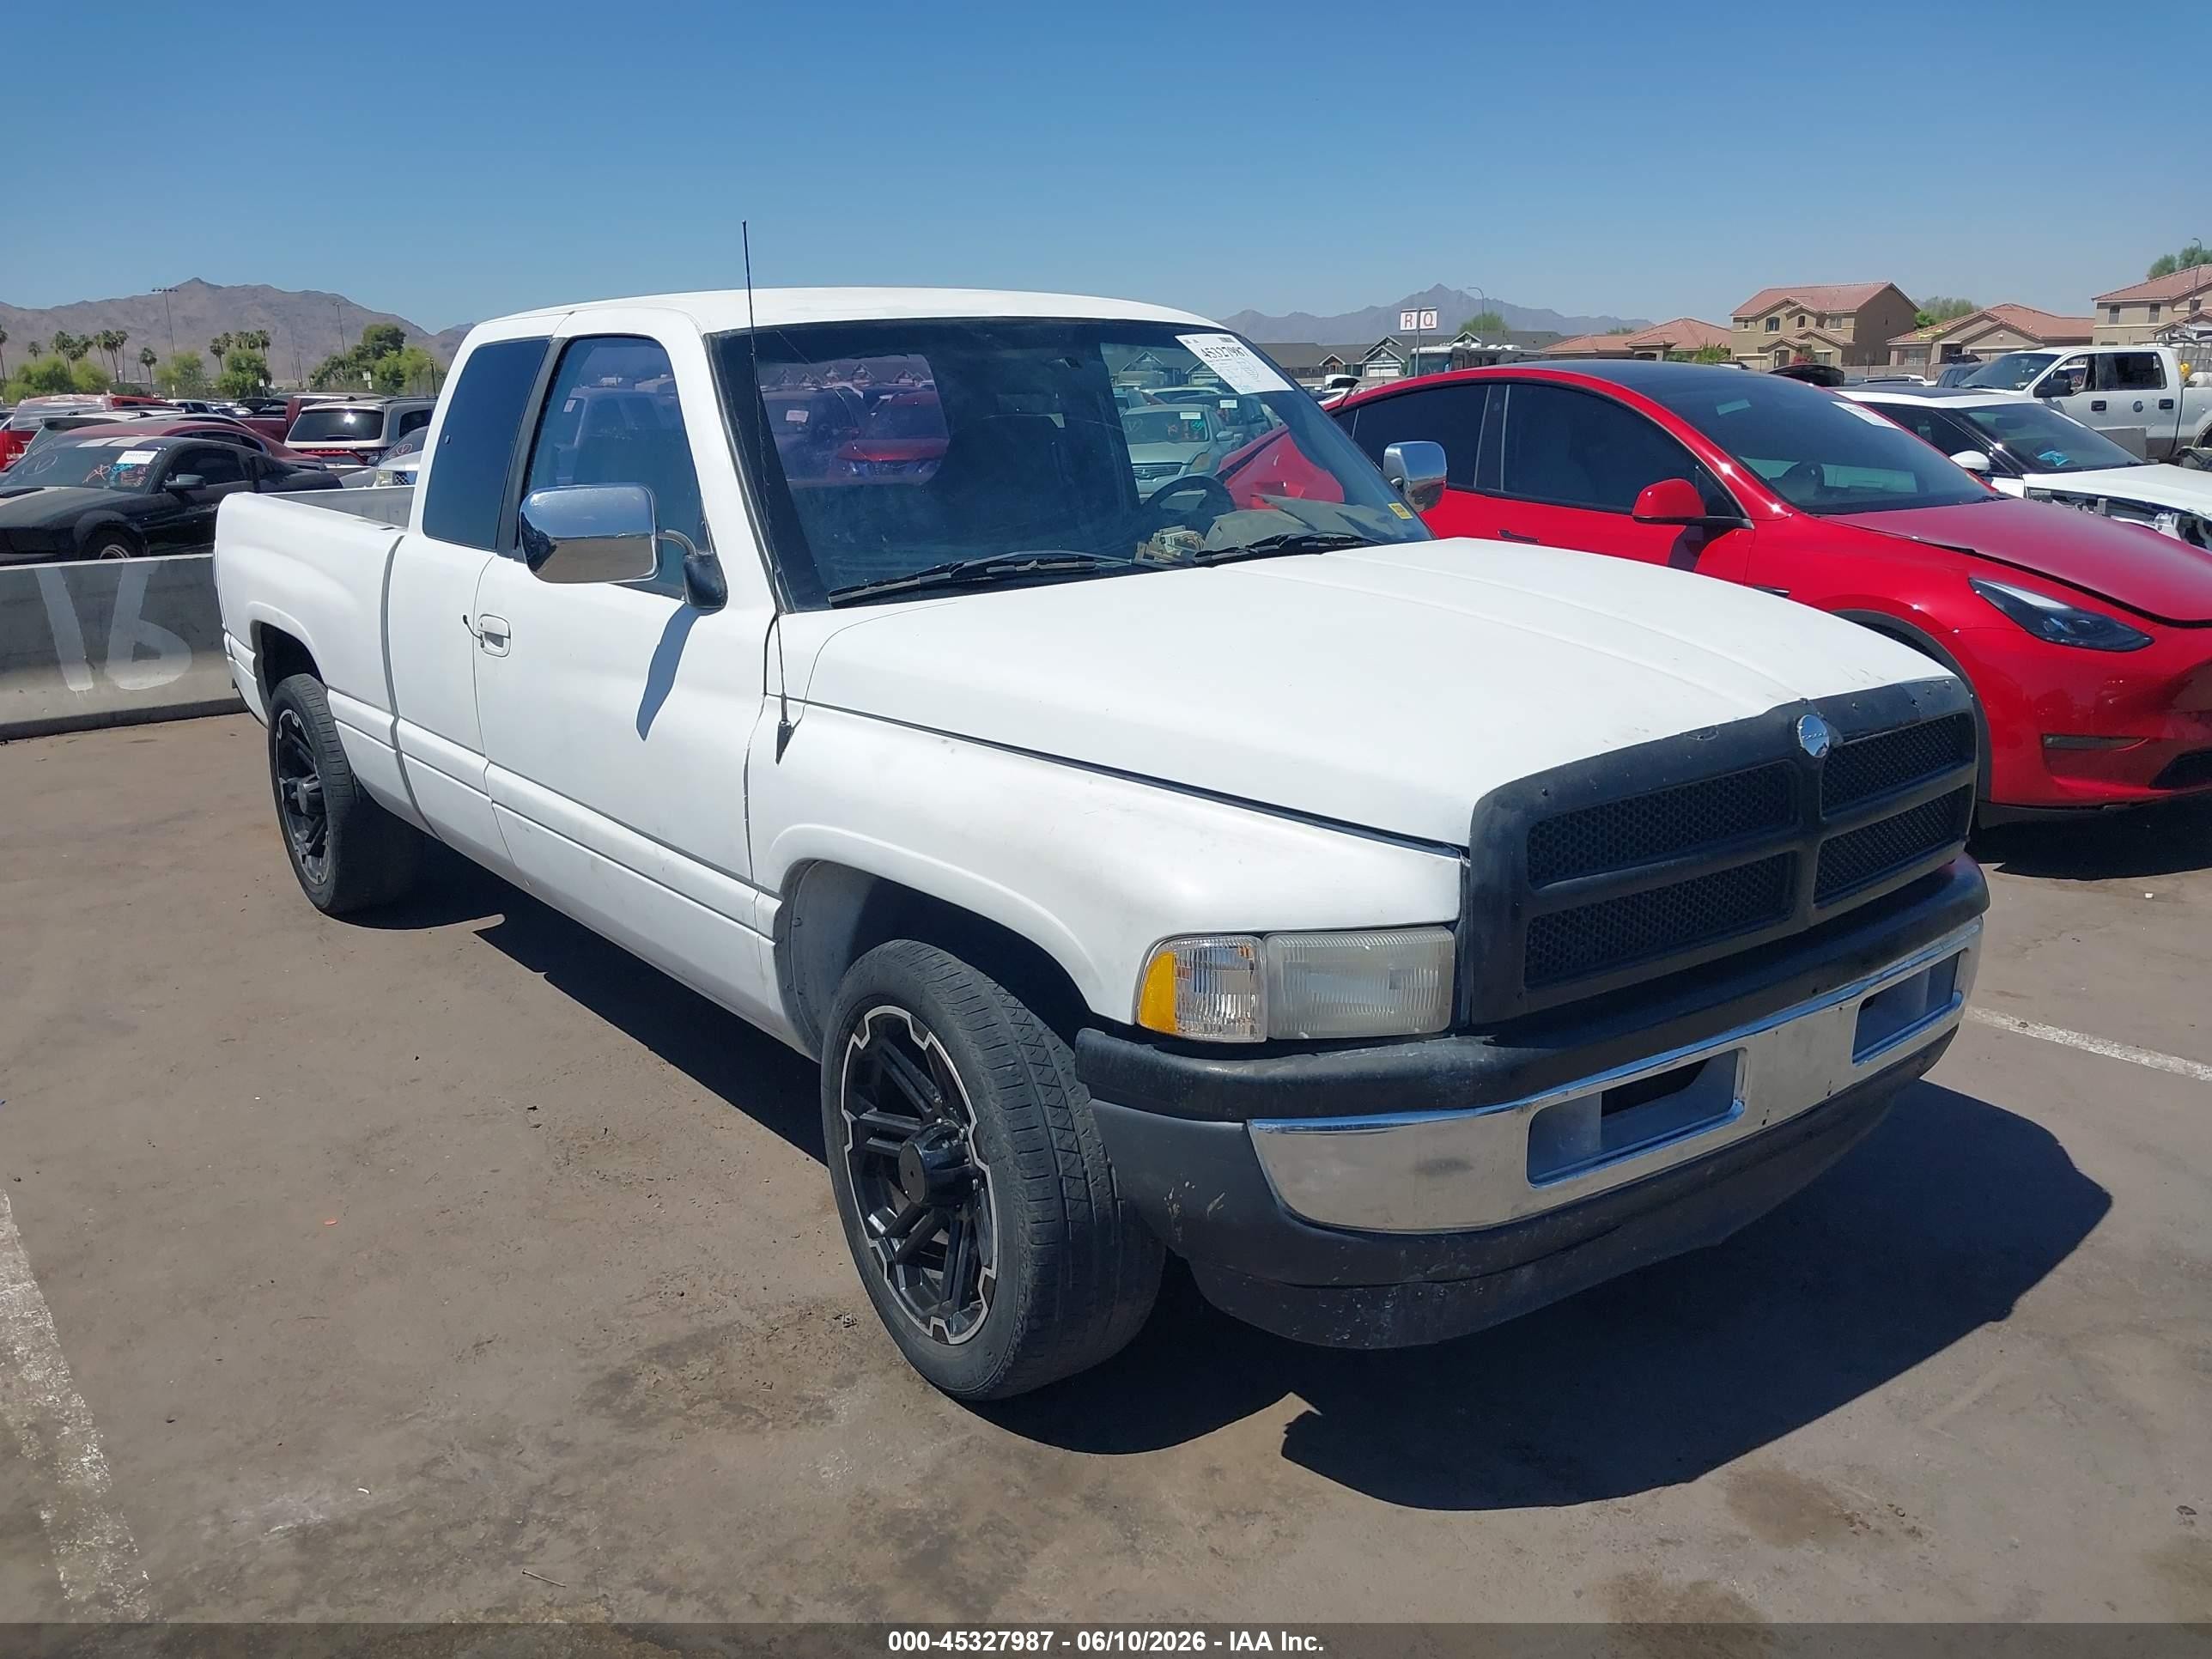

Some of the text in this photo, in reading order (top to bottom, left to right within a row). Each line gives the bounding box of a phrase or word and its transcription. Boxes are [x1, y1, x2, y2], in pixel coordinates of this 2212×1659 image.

[1404, 312, 1433, 328] R Q
[34, 561, 192, 690] 16
